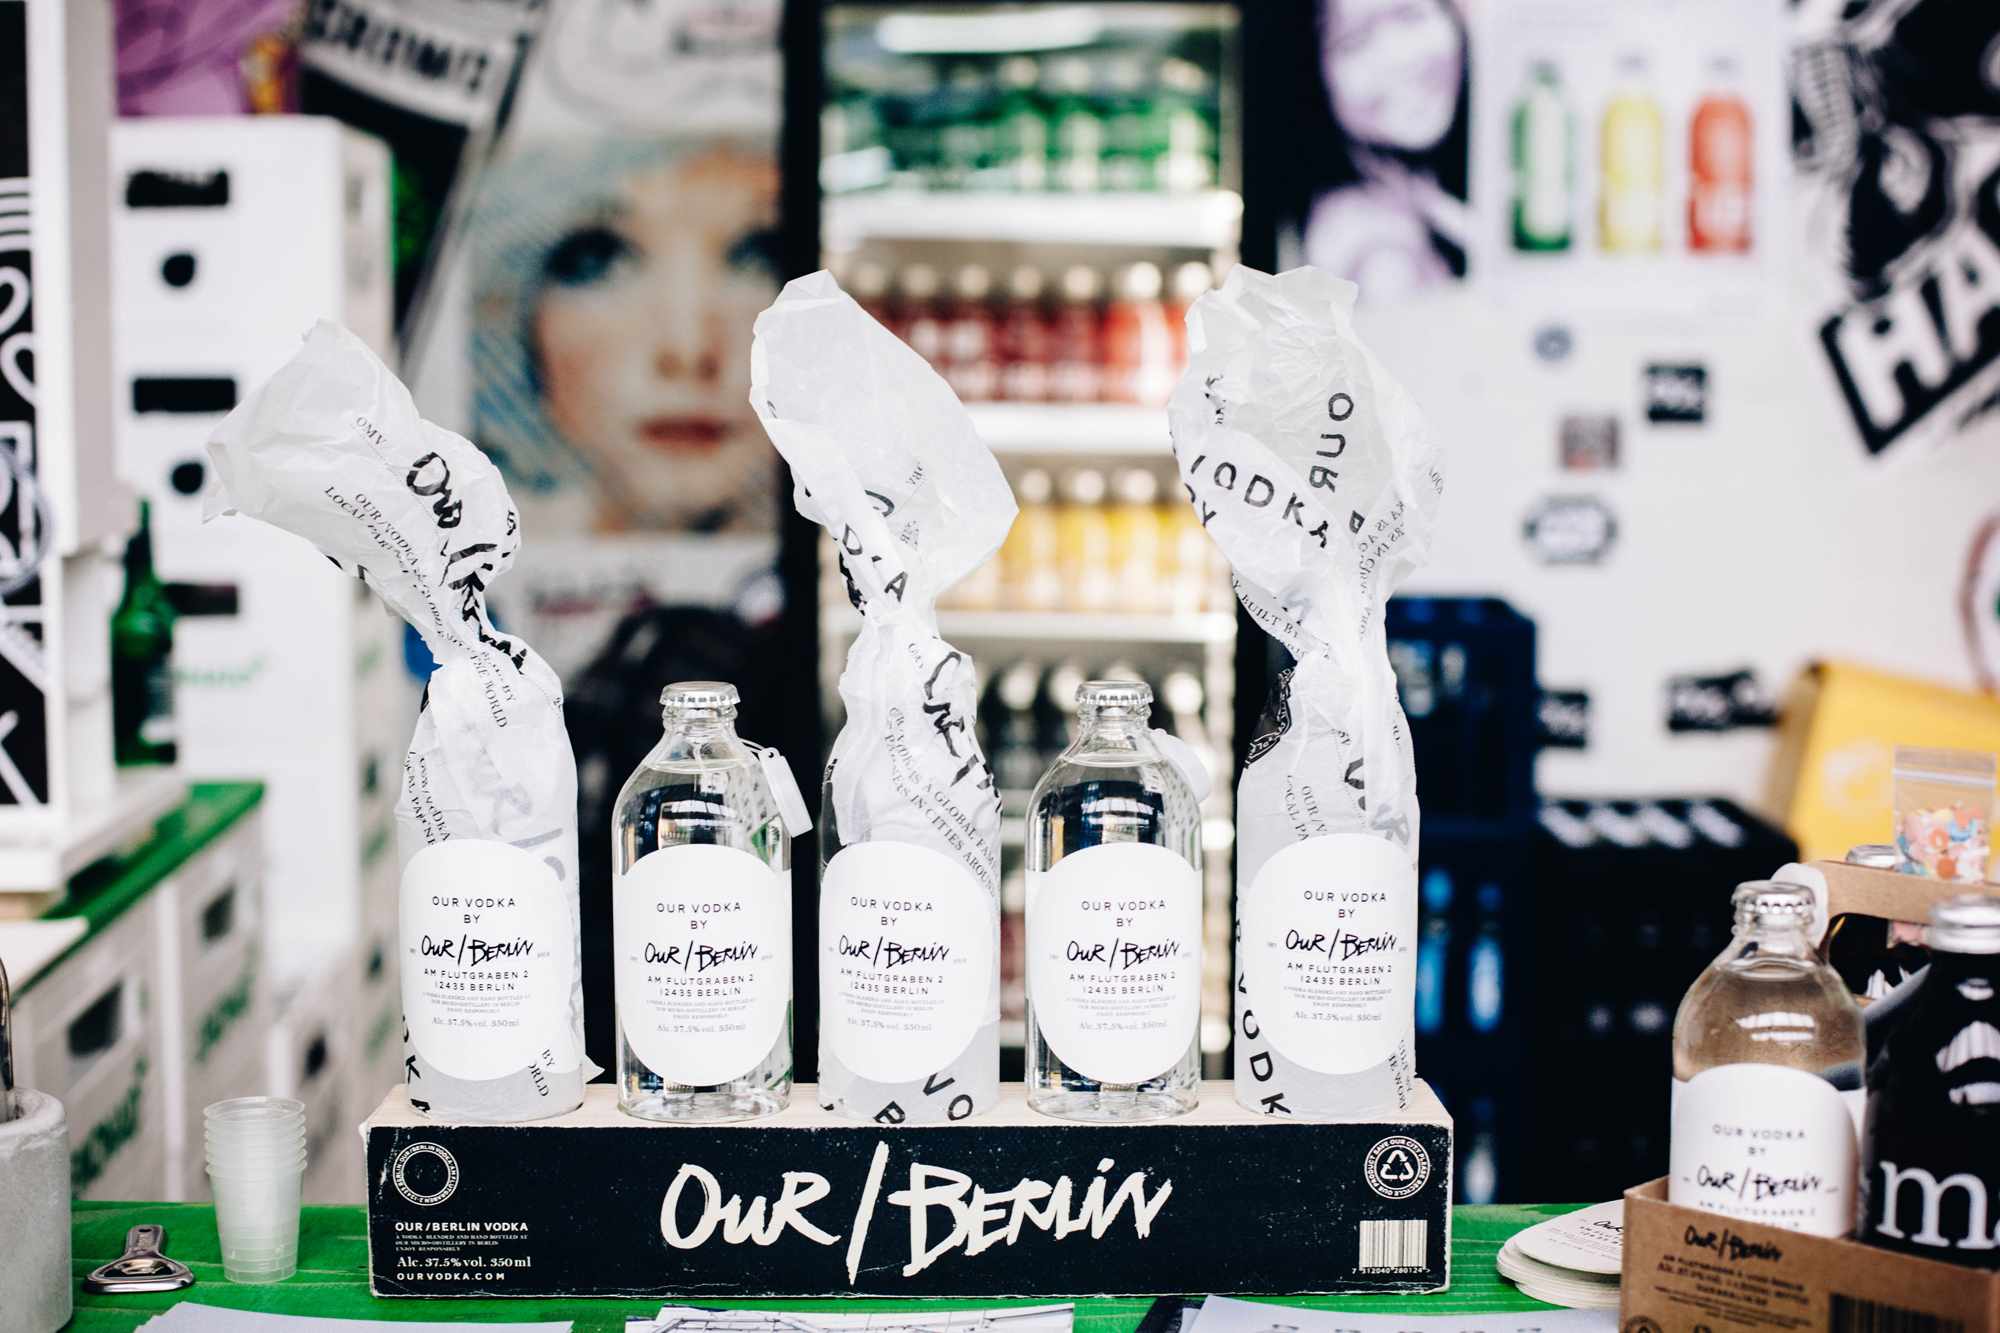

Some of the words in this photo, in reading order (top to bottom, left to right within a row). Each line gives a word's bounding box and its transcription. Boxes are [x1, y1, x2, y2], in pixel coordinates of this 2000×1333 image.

[482, 685, 509, 729] WORLD
[934, 791, 979, 841] GLOBAL
[925, 807, 965, 852] CITIES
[1304, 890, 1334, 901] OUR
[1341, 893, 1386, 902] VODKA
[432, 896, 459, 906] OUR
[465, 897, 516, 908] VODKA
[656, 902, 685, 913] OUR
[693, 902, 741, 913] VODKA
[850, 896, 877, 909] OUR
[883, 900, 933, 912] VODKA
[1081, 901, 1111, 912] OUR
[1118, 900, 1165, 912] VODKA
[464, 914, 480, 924] BY
[1338, 909, 1354, 918] BY
[690, 920, 707, 930] BY
[881, 916, 898, 926] BY
[1116, 918, 1133, 927] BY
[1287, 962, 1303, 971] AM
[1308, 964, 1384, 974] FLUTGRABEN
[424, 969, 437, 977] AM
[441, 971, 519, 980] FLUTGRABEN
[840, 968, 852, 976] AM
[856, 970, 933, 983] FLUTGRABEN
[1090, 972, 1167, 983] FLUTGRABEN
[435, 981, 465, 991] 12435
[470, 983, 515, 991] BERLIN
[648, 976, 661, 985] AM
[666, 975, 744, 986] FLUTGRABEN
[1300, 975, 1334, 985] 12435
[1339, 977, 1380, 986] BERLIN
[659, 987, 692, 997] 12435
[697, 987, 741, 997] BERLIN
[850, 982, 879, 992] 12435
[884, 985, 928, 995] BERLIN
[1083, 985, 1117, 994] 12435
[1121, 985, 1164, 994] BERLIN
[1713, 1123, 1744, 1136] OUR
[1407, 1141, 1421, 1152] CITY
[484, 1222, 529, 1232] VODKA
[397, 1256, 422, 1267] Alc.
[425, 1258, 461, 1267] 37.5%
